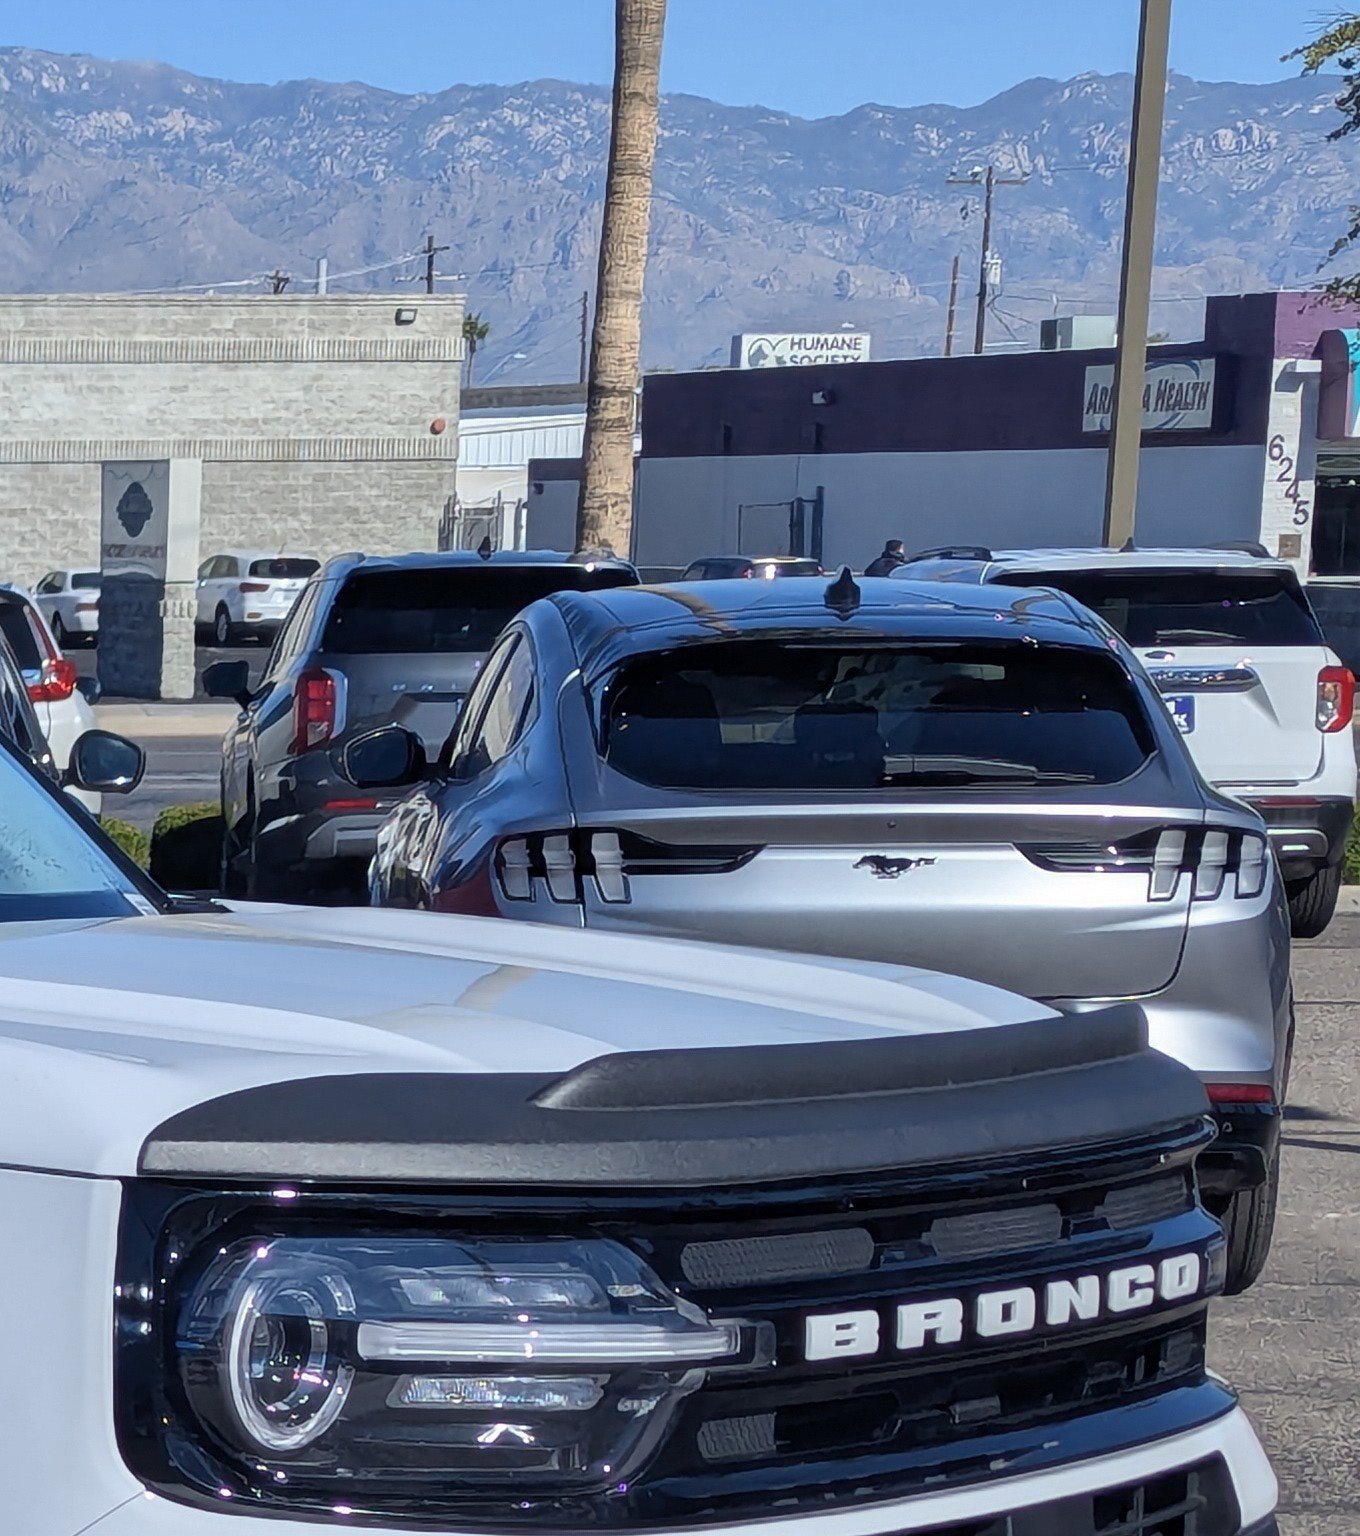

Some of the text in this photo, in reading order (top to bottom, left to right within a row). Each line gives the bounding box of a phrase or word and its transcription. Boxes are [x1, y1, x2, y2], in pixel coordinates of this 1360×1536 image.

[790, 337, 862, 351] HUMANE
[1268, 434, 1310, 525] 6245
[805, 1253, 1200, 1361] BRONCO
